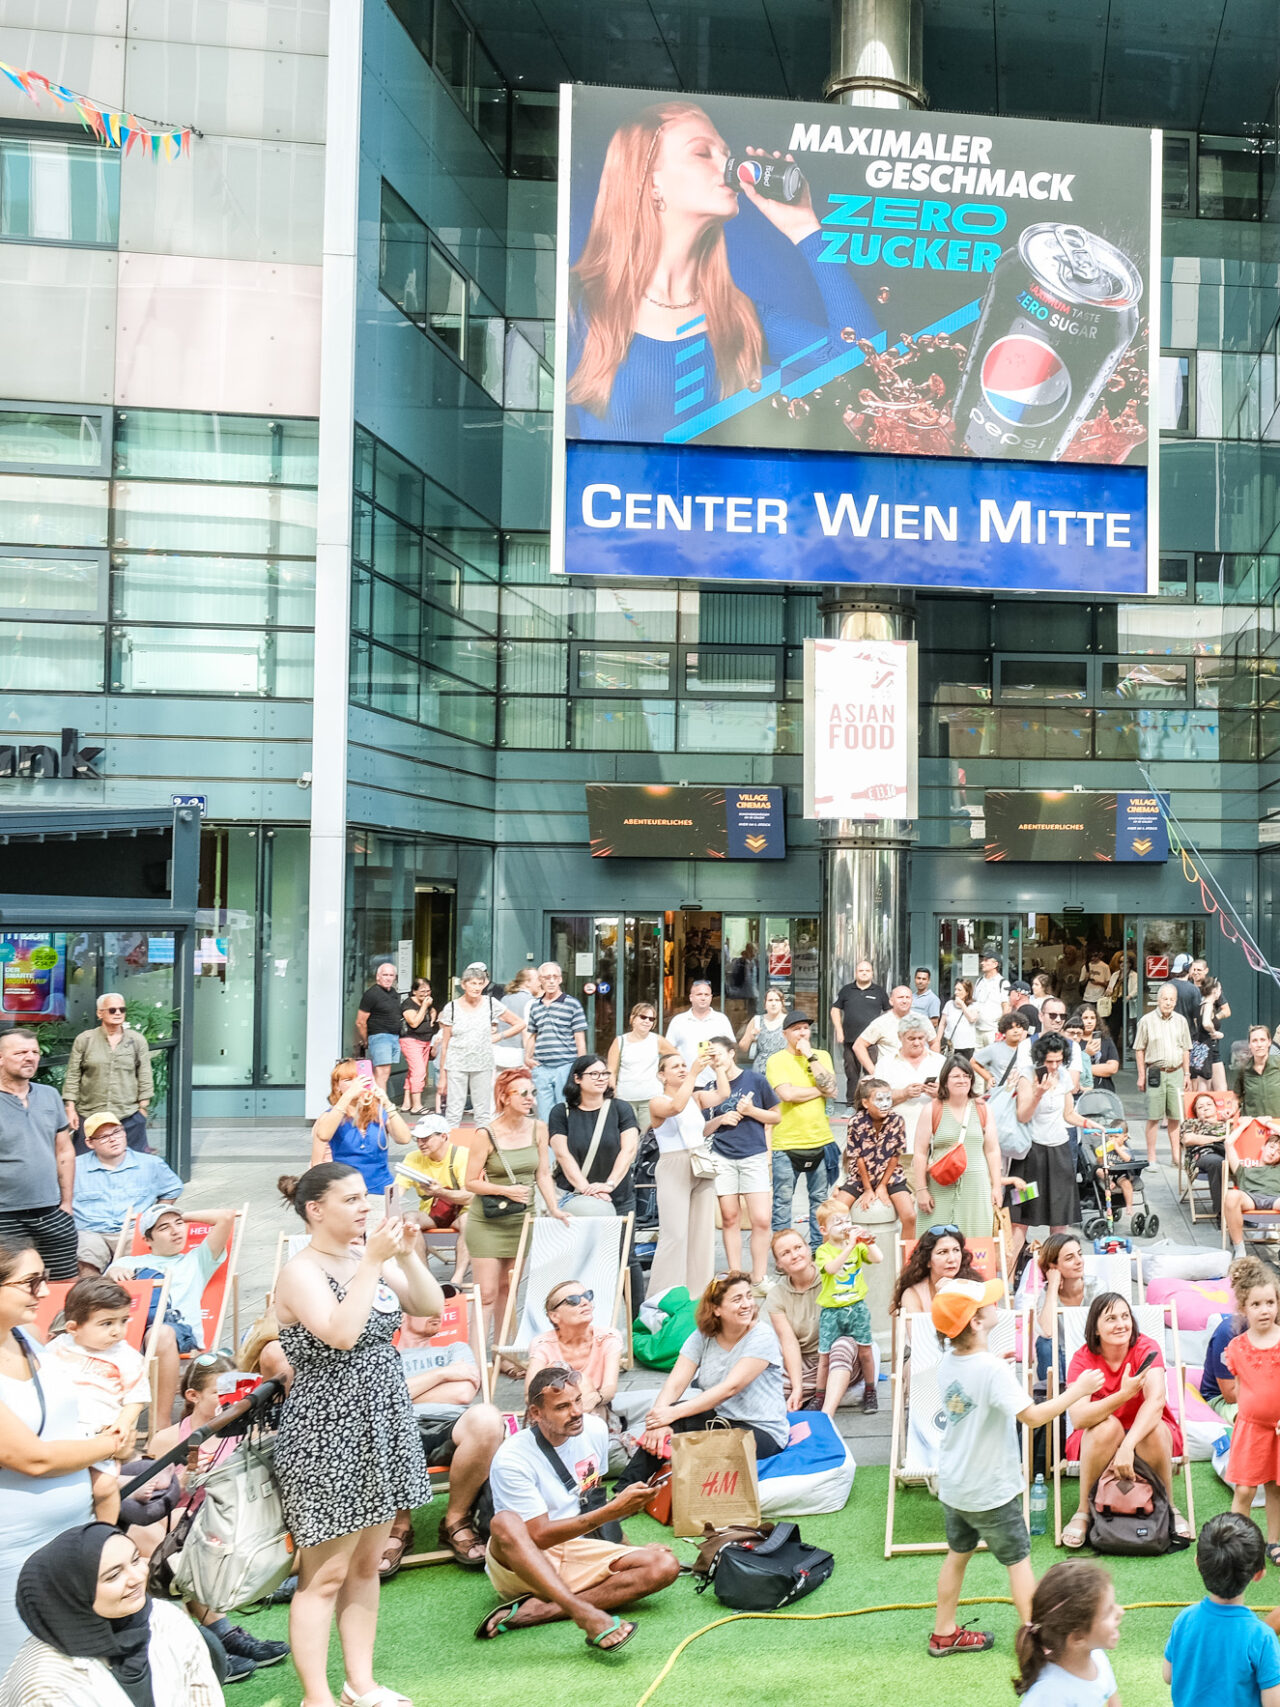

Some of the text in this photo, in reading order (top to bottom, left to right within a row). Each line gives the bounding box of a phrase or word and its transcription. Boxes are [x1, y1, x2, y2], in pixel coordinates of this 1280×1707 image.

[788, 123, 993, 165] MAXIMALER
[865, 160, 1076, 202] GESCHMACK
[821, 193, 1008, 236] ZERO
[817, 231, 1001, 273] ZUCKER
[1016, 290, 1098, 339] ZERO SUGAR
[1072, 308, 1102, 324] TASTE
[969, 407, 1046, 450] pepsi
[581, 483, 1132, 549] CENTER WIEN MITTE
[829, 703, 895, 723] ASIAN
[829, 723, 895, 750] FOOD
[623, 818, 693, 826] ABENTEUERLICHES
[1018, 823, 1084, 831] ABENTEUERLICHES
[700, 1470, 739, 1497] H&M
